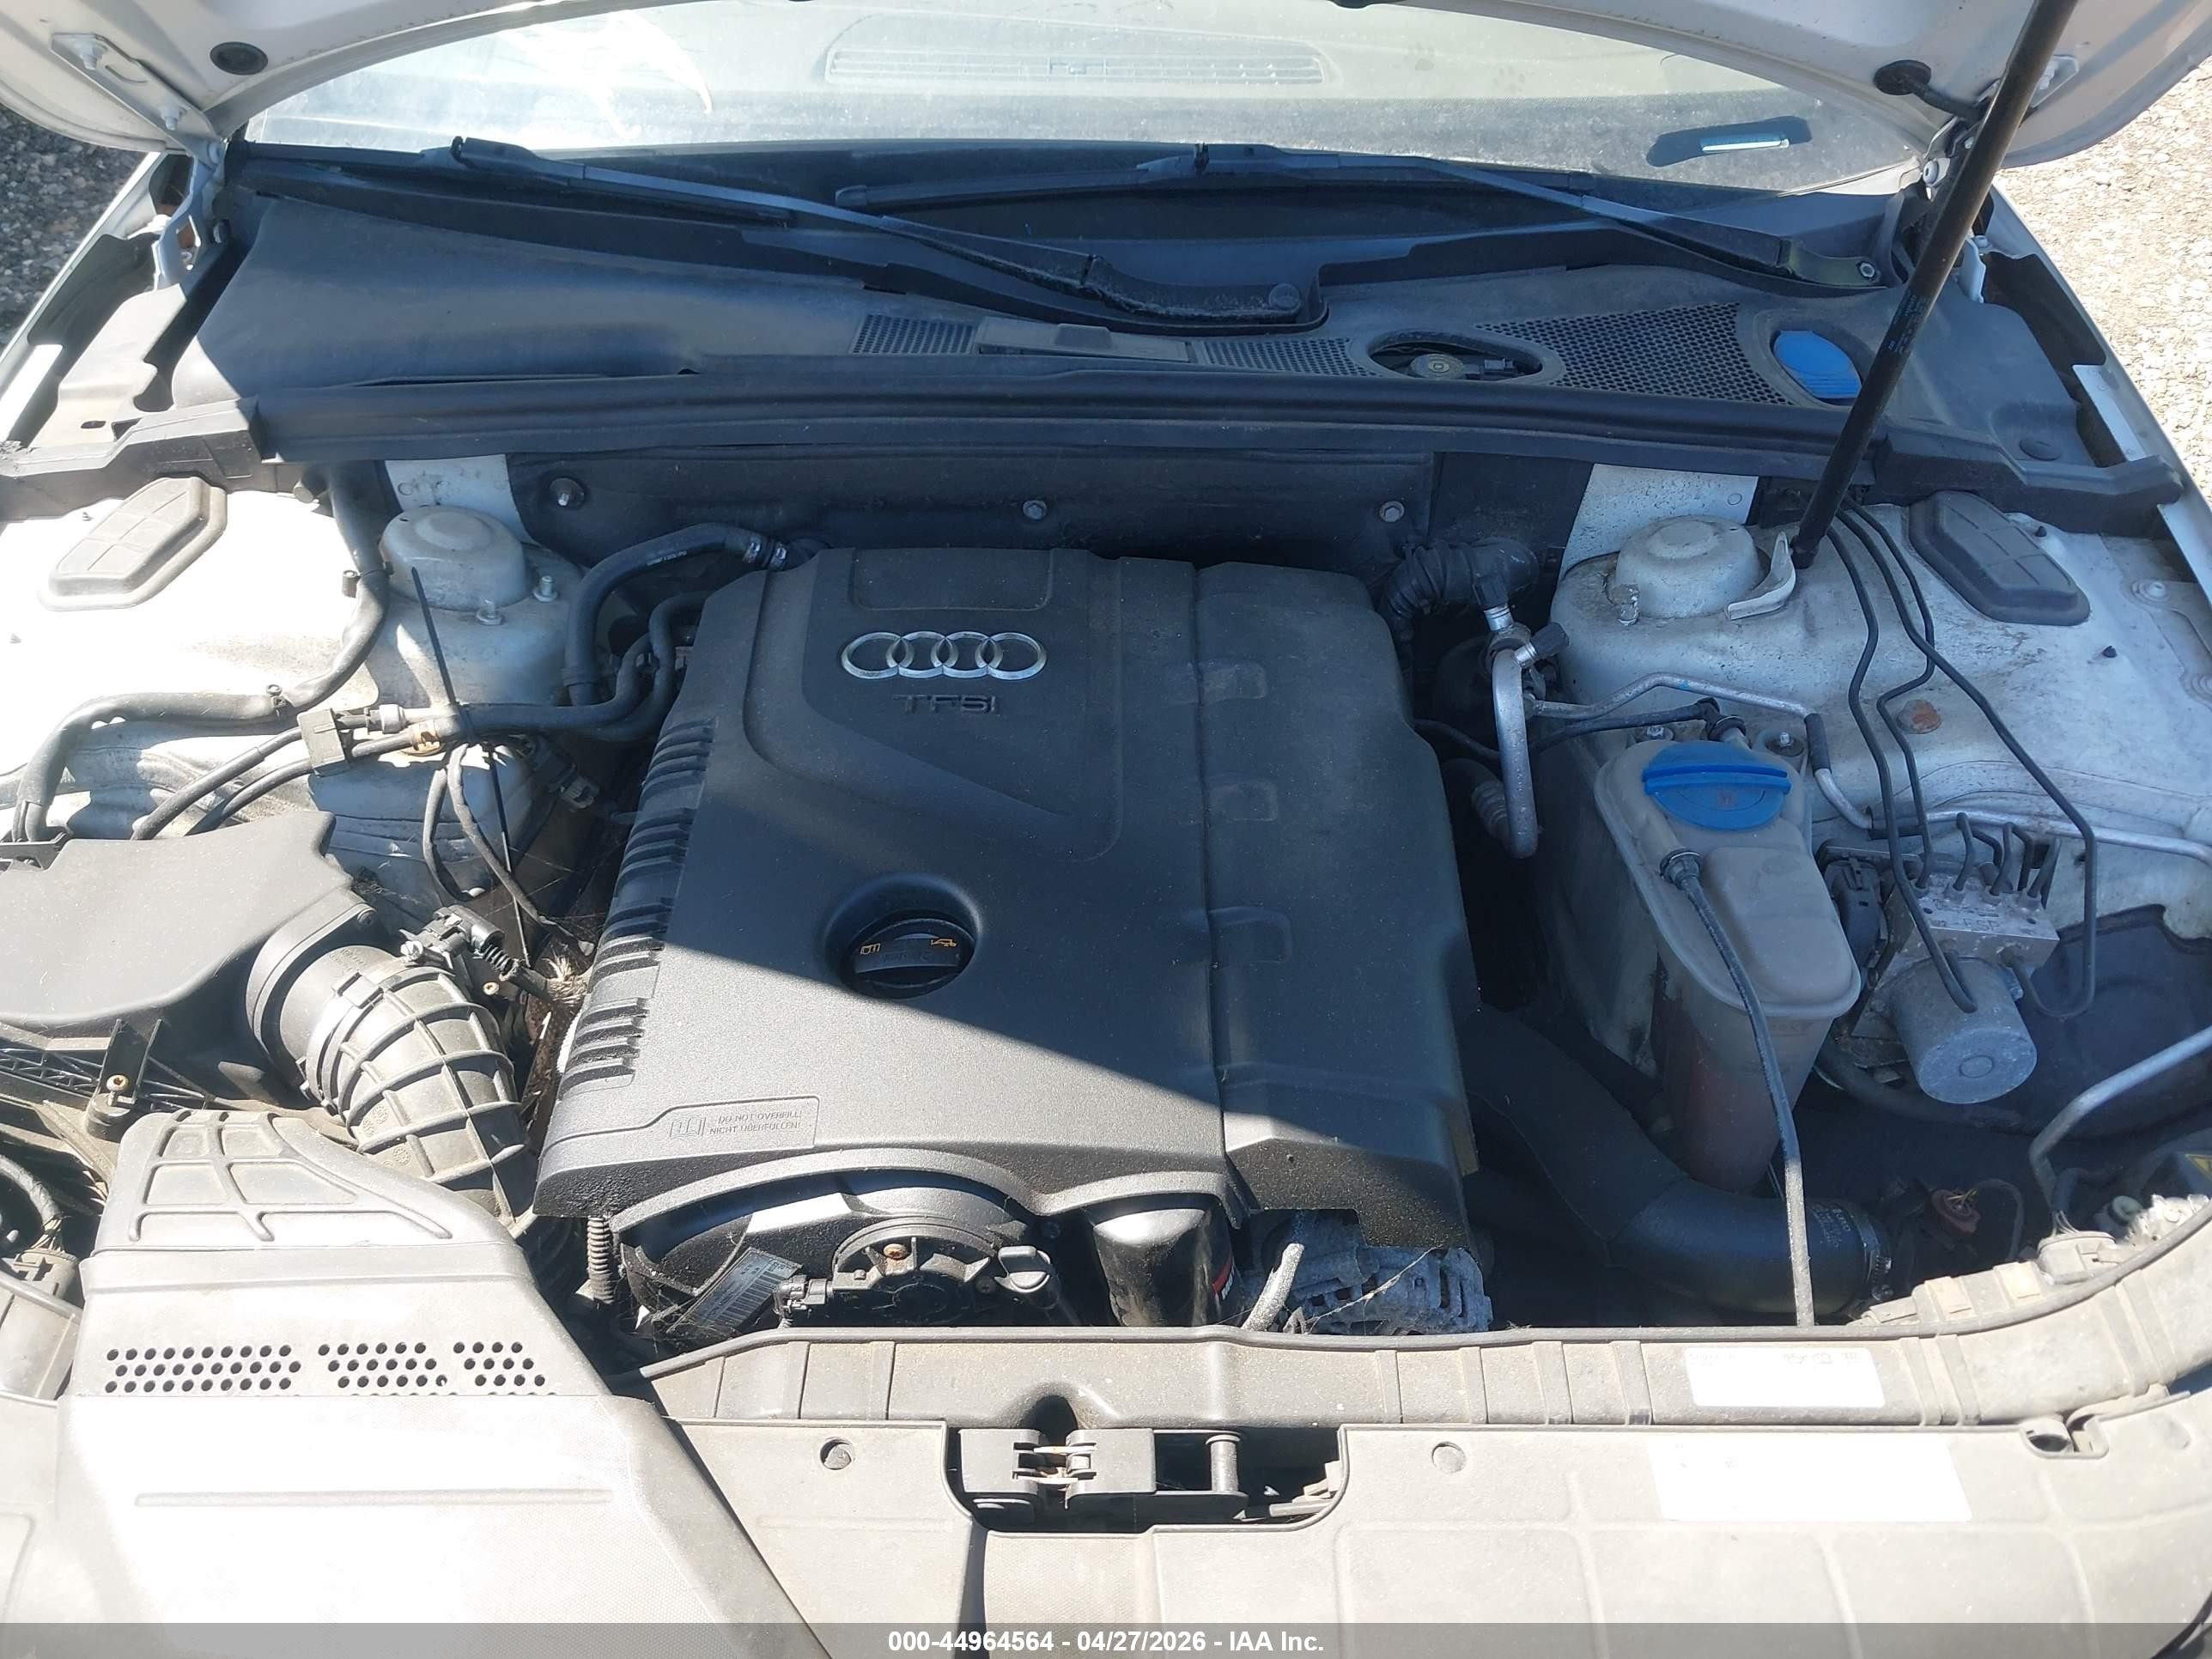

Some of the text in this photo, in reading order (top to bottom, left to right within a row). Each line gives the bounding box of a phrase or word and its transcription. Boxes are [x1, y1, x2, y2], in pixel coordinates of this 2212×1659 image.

[892, 694, 997, 714] TFSI
[735, 1113, 754, 1122] NOT
[708, 1125, 738, 1134] NICHT
